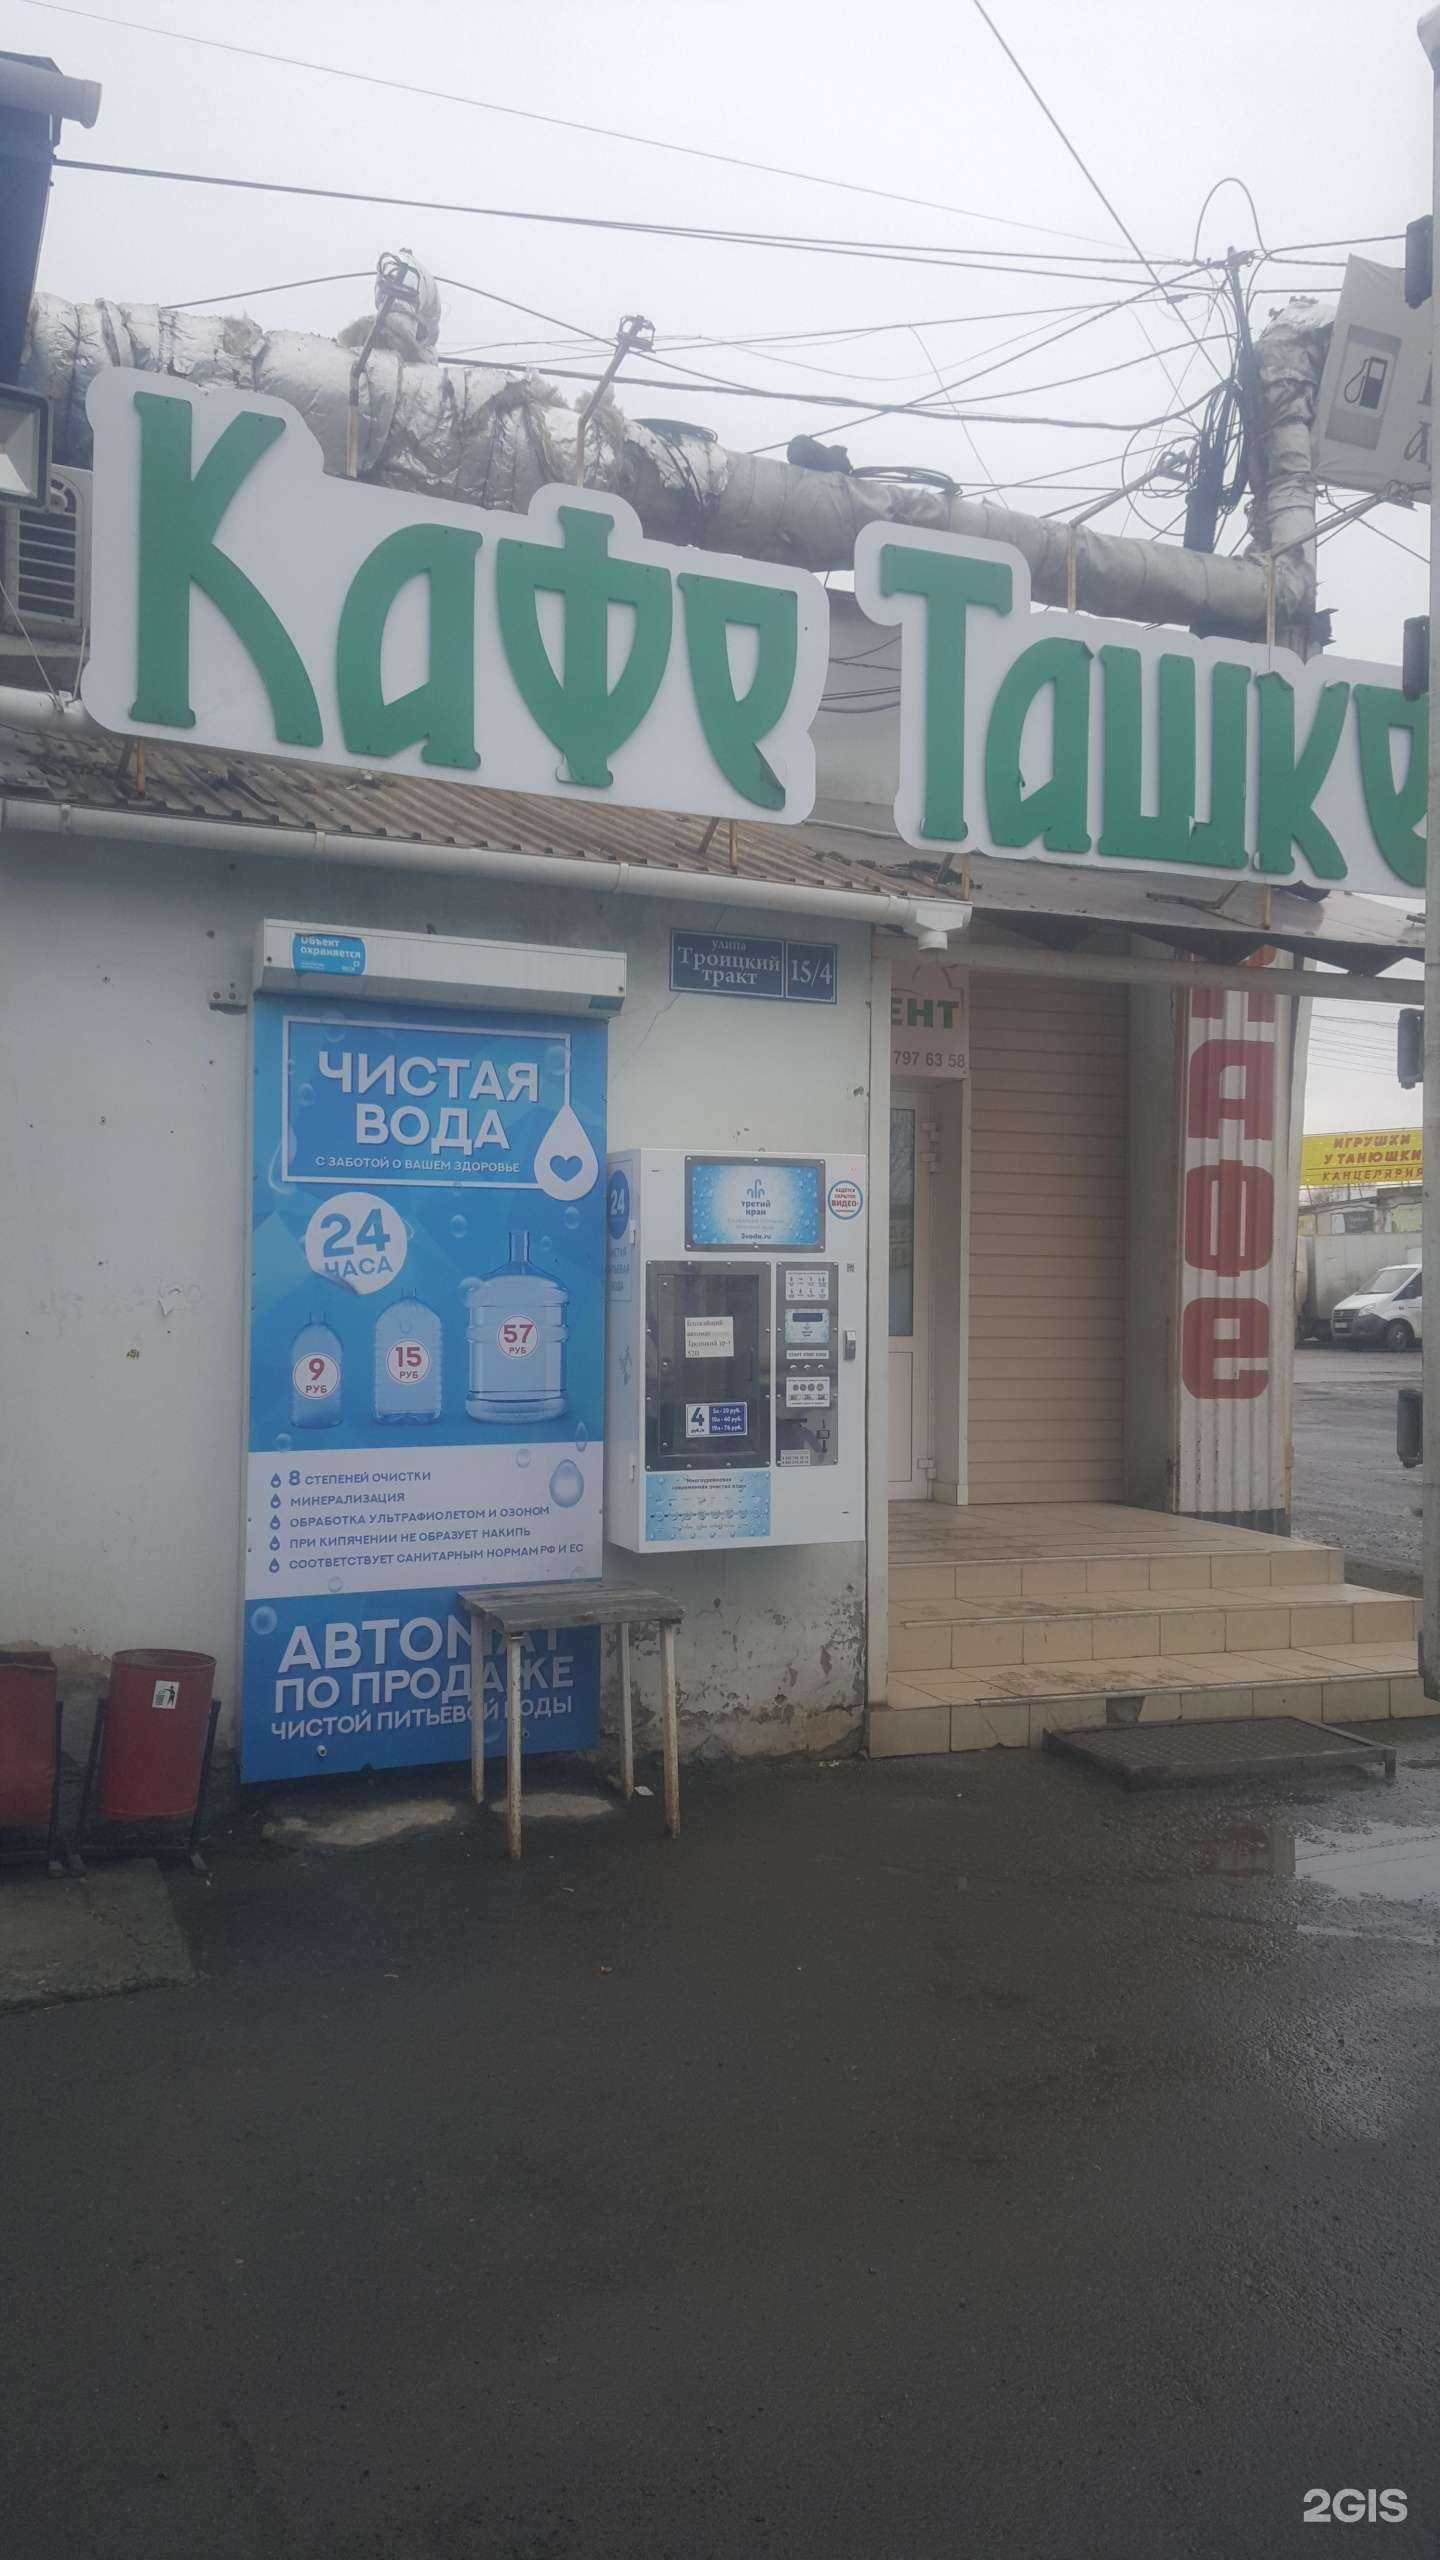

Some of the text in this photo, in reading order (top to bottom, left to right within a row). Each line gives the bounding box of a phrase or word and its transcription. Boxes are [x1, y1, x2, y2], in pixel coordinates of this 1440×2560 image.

[131, 391, 798, 810] Кафе
[300, 946, 361, 960] охраняется
[712, 938, 747, 951] улица
[677, 945, 833, 989] Троицкий 15/4
[702, 968, 758, 987] тракт
[893, 1050, 966, 1069] 797 63 58
[318, 1050, 539, 1103] ЧИСТАЯ
[355, 1102, 511, 1156] ВОДА
[1333, 1134, 1411, 1149] ИГРУШКИ
[315, 1156, 521, 1173] С ЗАБОТОЙ О ВАШЕМ ЗДОРОВЬЕ
[1323, 1149, 1422, 1165] У ТАНЮШКИ
[610, 1189, 625, 1216] 24
[741, 1199, 771, 1209] третий
[745, 1208, 767, 1217] кран
[320, 1208, 391, 1258] 24
[324, 1255, 394, 1277] ЧАСА
[503, 1324, 534, 1343] 57
[395, 1346, 422, 1368] 15
[509, 1346, 527, 1354] РУБ
[308, 1357, 326, 1382] 9
[399, 1370, 418, 1379] РУБ
[305, 1384, 327, 1394] РУБ
[691, 1406, 705, 1427] 4
[288, 1470, 432, 1486] 8 СТЕПЕНЕЙ ОЧИСТКИ
[290, 1492, 406, 1508] МИНЕРАЛИЗАЦИЯ
[289, 1505, 550, 1528] ОБРАБОТКА УЛЬТРАФИОЛЕТОМ И ОЗОНОМ
[289, 1527, 531, 1549] ПРИ КИПЯЧЕНИИ НЕ ОБРАЗУЕТ НАКИПЬ
[289, 1543, 584, 1570] СООТВЕТСТВУЕТ САНИТАРНЫМ НОРМАМ РФ И ЕС
[275, 1675, 340, 1714] ПО
[271, 1709, 372, 1740] ЧИСТОЙ
[505, 1695, 572, 1719] ОДЫ
